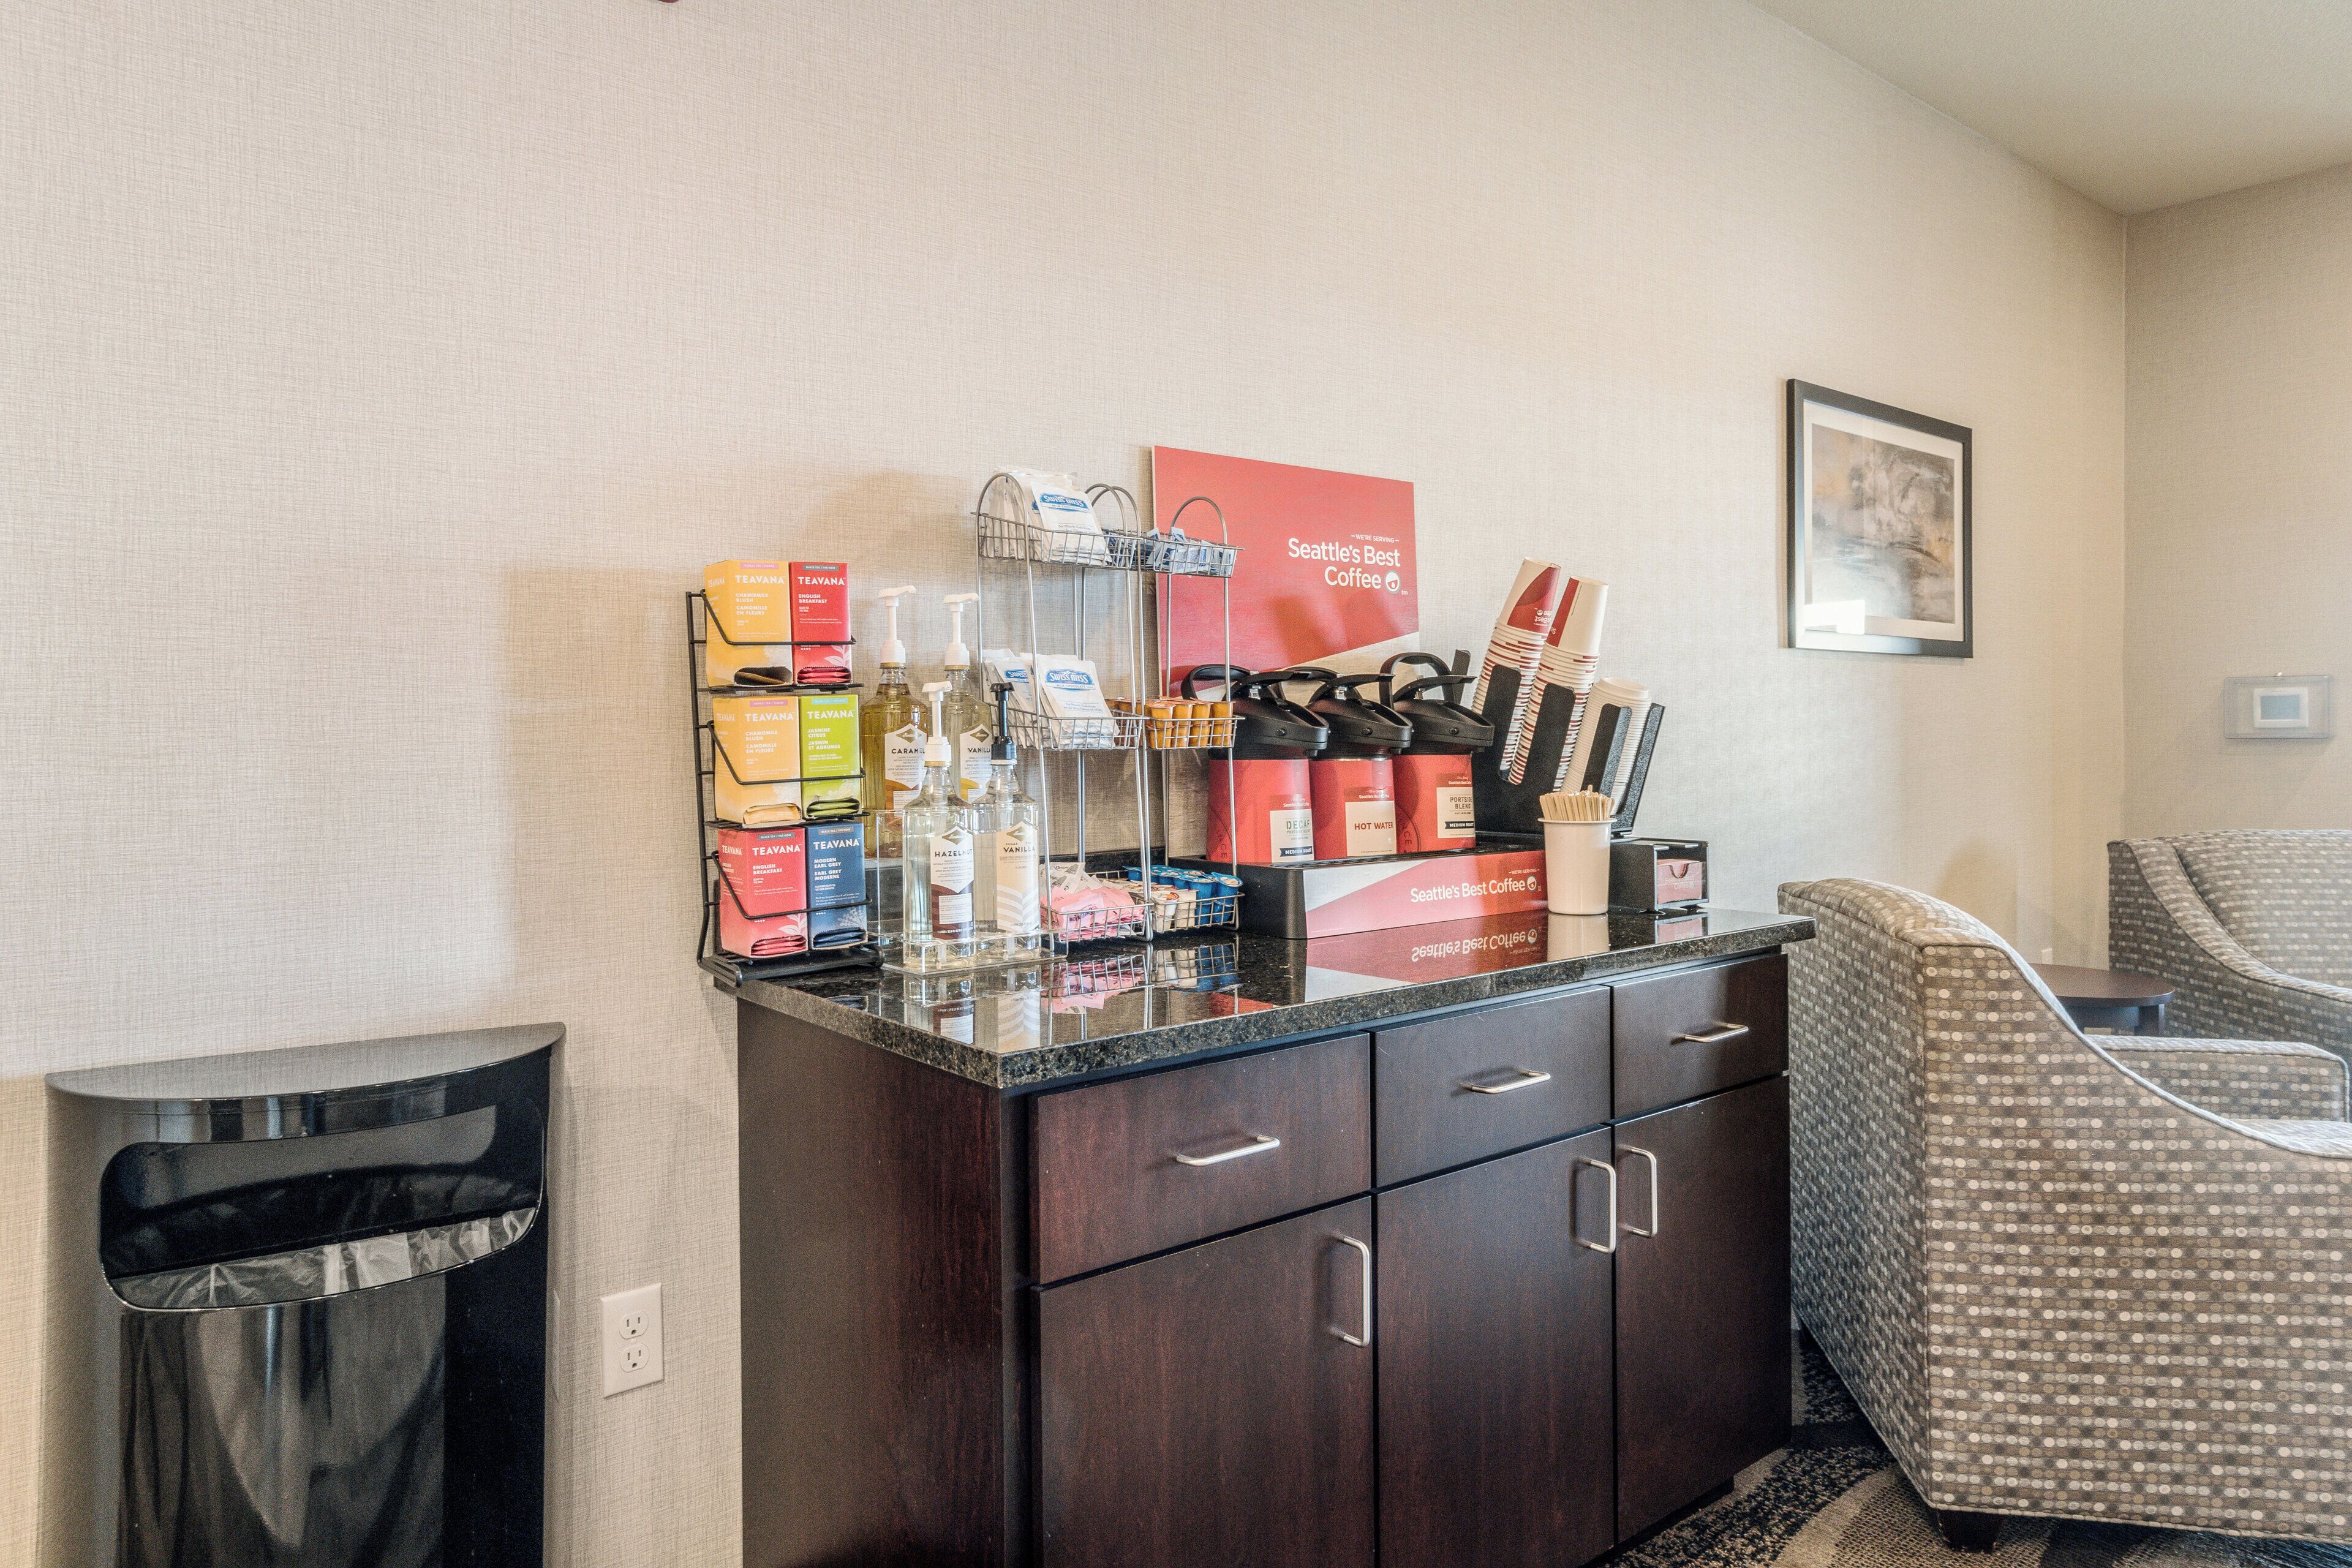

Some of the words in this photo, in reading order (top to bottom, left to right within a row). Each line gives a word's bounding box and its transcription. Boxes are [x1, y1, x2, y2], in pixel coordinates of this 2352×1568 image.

[1288, 538, 1360, 564] Seattle's
[1364, 545, 1401, 567] Best
[735, 575, 785, 584] TEAVANA
[797, 576, 845, 586] TEAVANA
[1325, 566, 1382, 589] Coffee
[717, 713, 736, 722] TEAVANA
[745, 712, 794, 722] TEAVANA
[807, 710, 854, 720] TEAVANA
[1286, 820, 1310, 830] DECAF
[813, 839, 860, 850] TEAVANA
[722, 845, 742, 856] TEAVANA
[752, 844, 801, 856] TEAVANA
[935, 849, 972, 858] HAZELNUT
[1411, 884, 1460, 903] Seattle's
[1461, 881, 1488, 897] Best
[1488, 878, 1526, 895] Coffee
